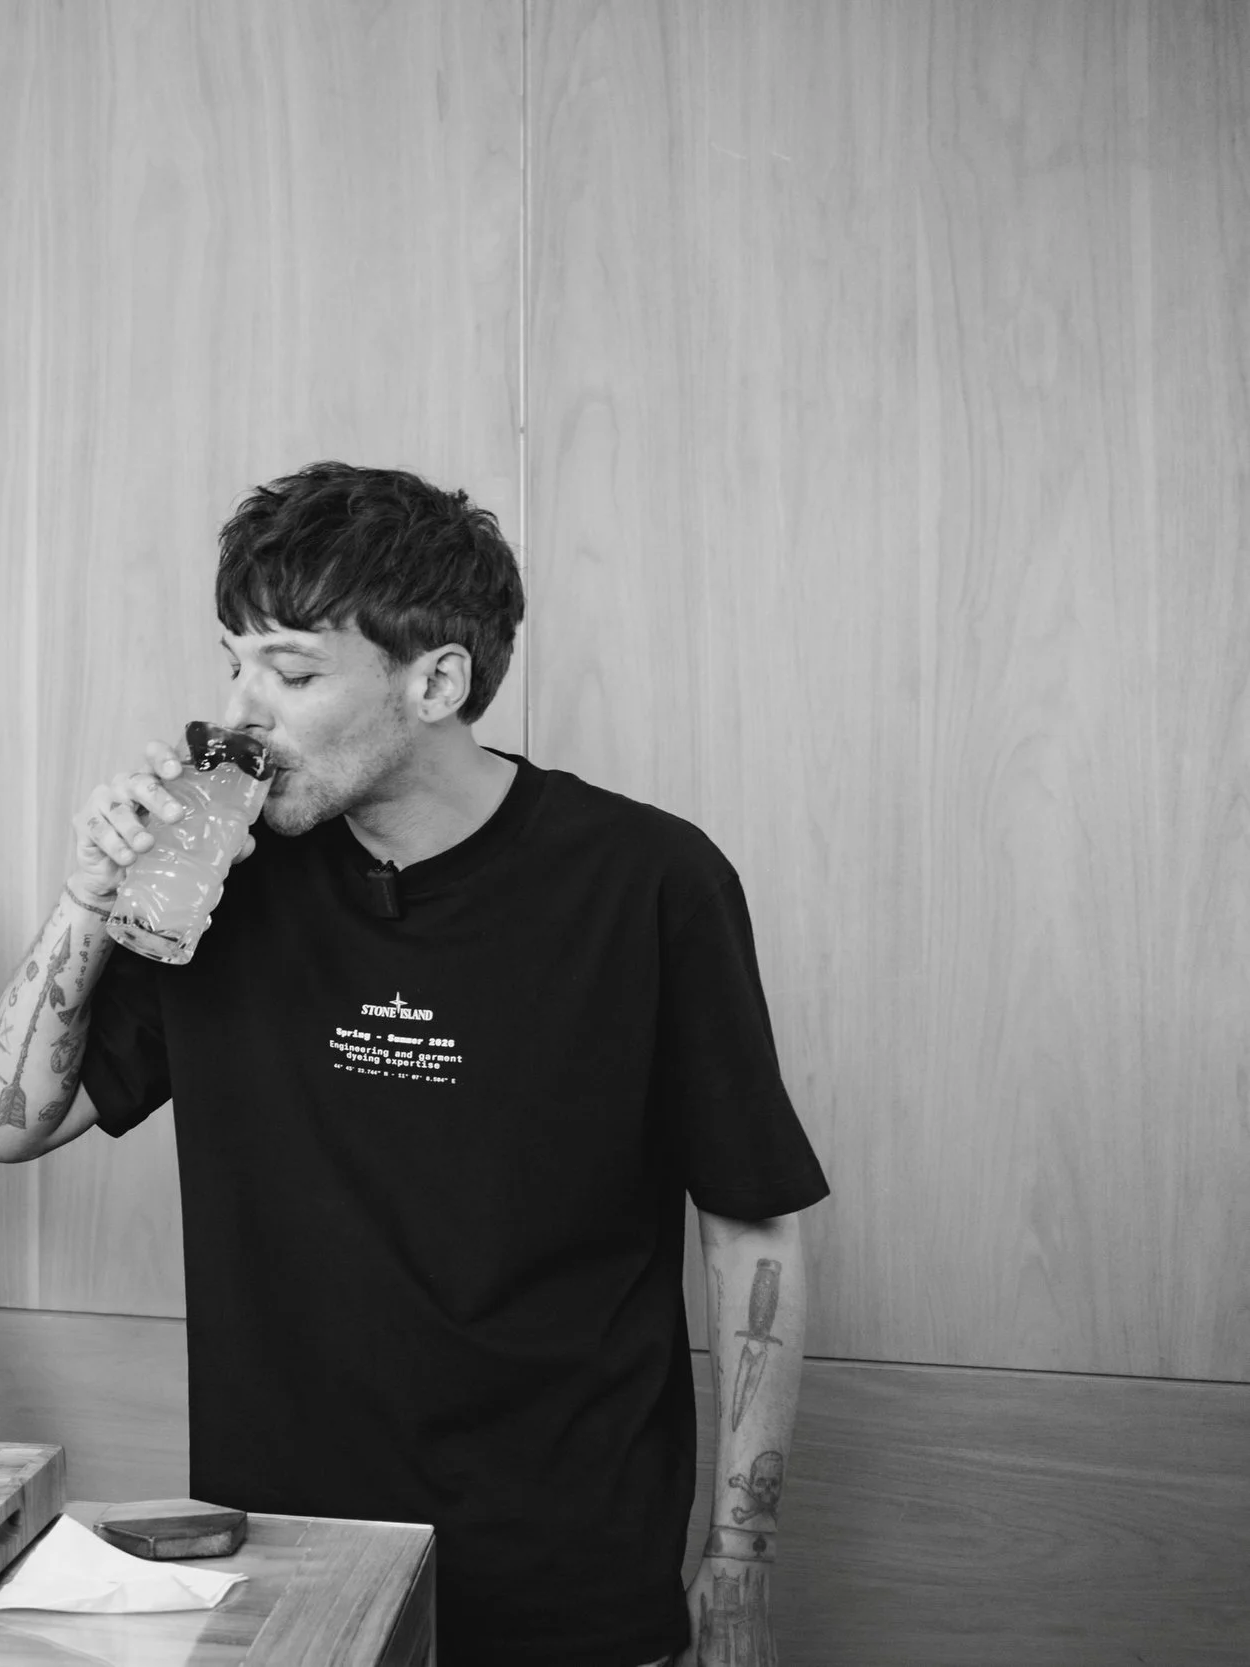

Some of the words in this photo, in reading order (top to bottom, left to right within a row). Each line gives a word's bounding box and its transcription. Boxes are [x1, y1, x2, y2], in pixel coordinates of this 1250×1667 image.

[361, 1004, 396, 1018] STONE
[400, 1008, 434, 1021] ISLAND
[336, 1027, 371, 1041] Spring
[329, 1040, 389, 1058] Engineering
[394, 1050, 413, 1059] and
[418, 1053, 463, 1063] garment
[346, 1051, 380, 1065] dyeing
[385, 1057, 440, 1069] expertise
